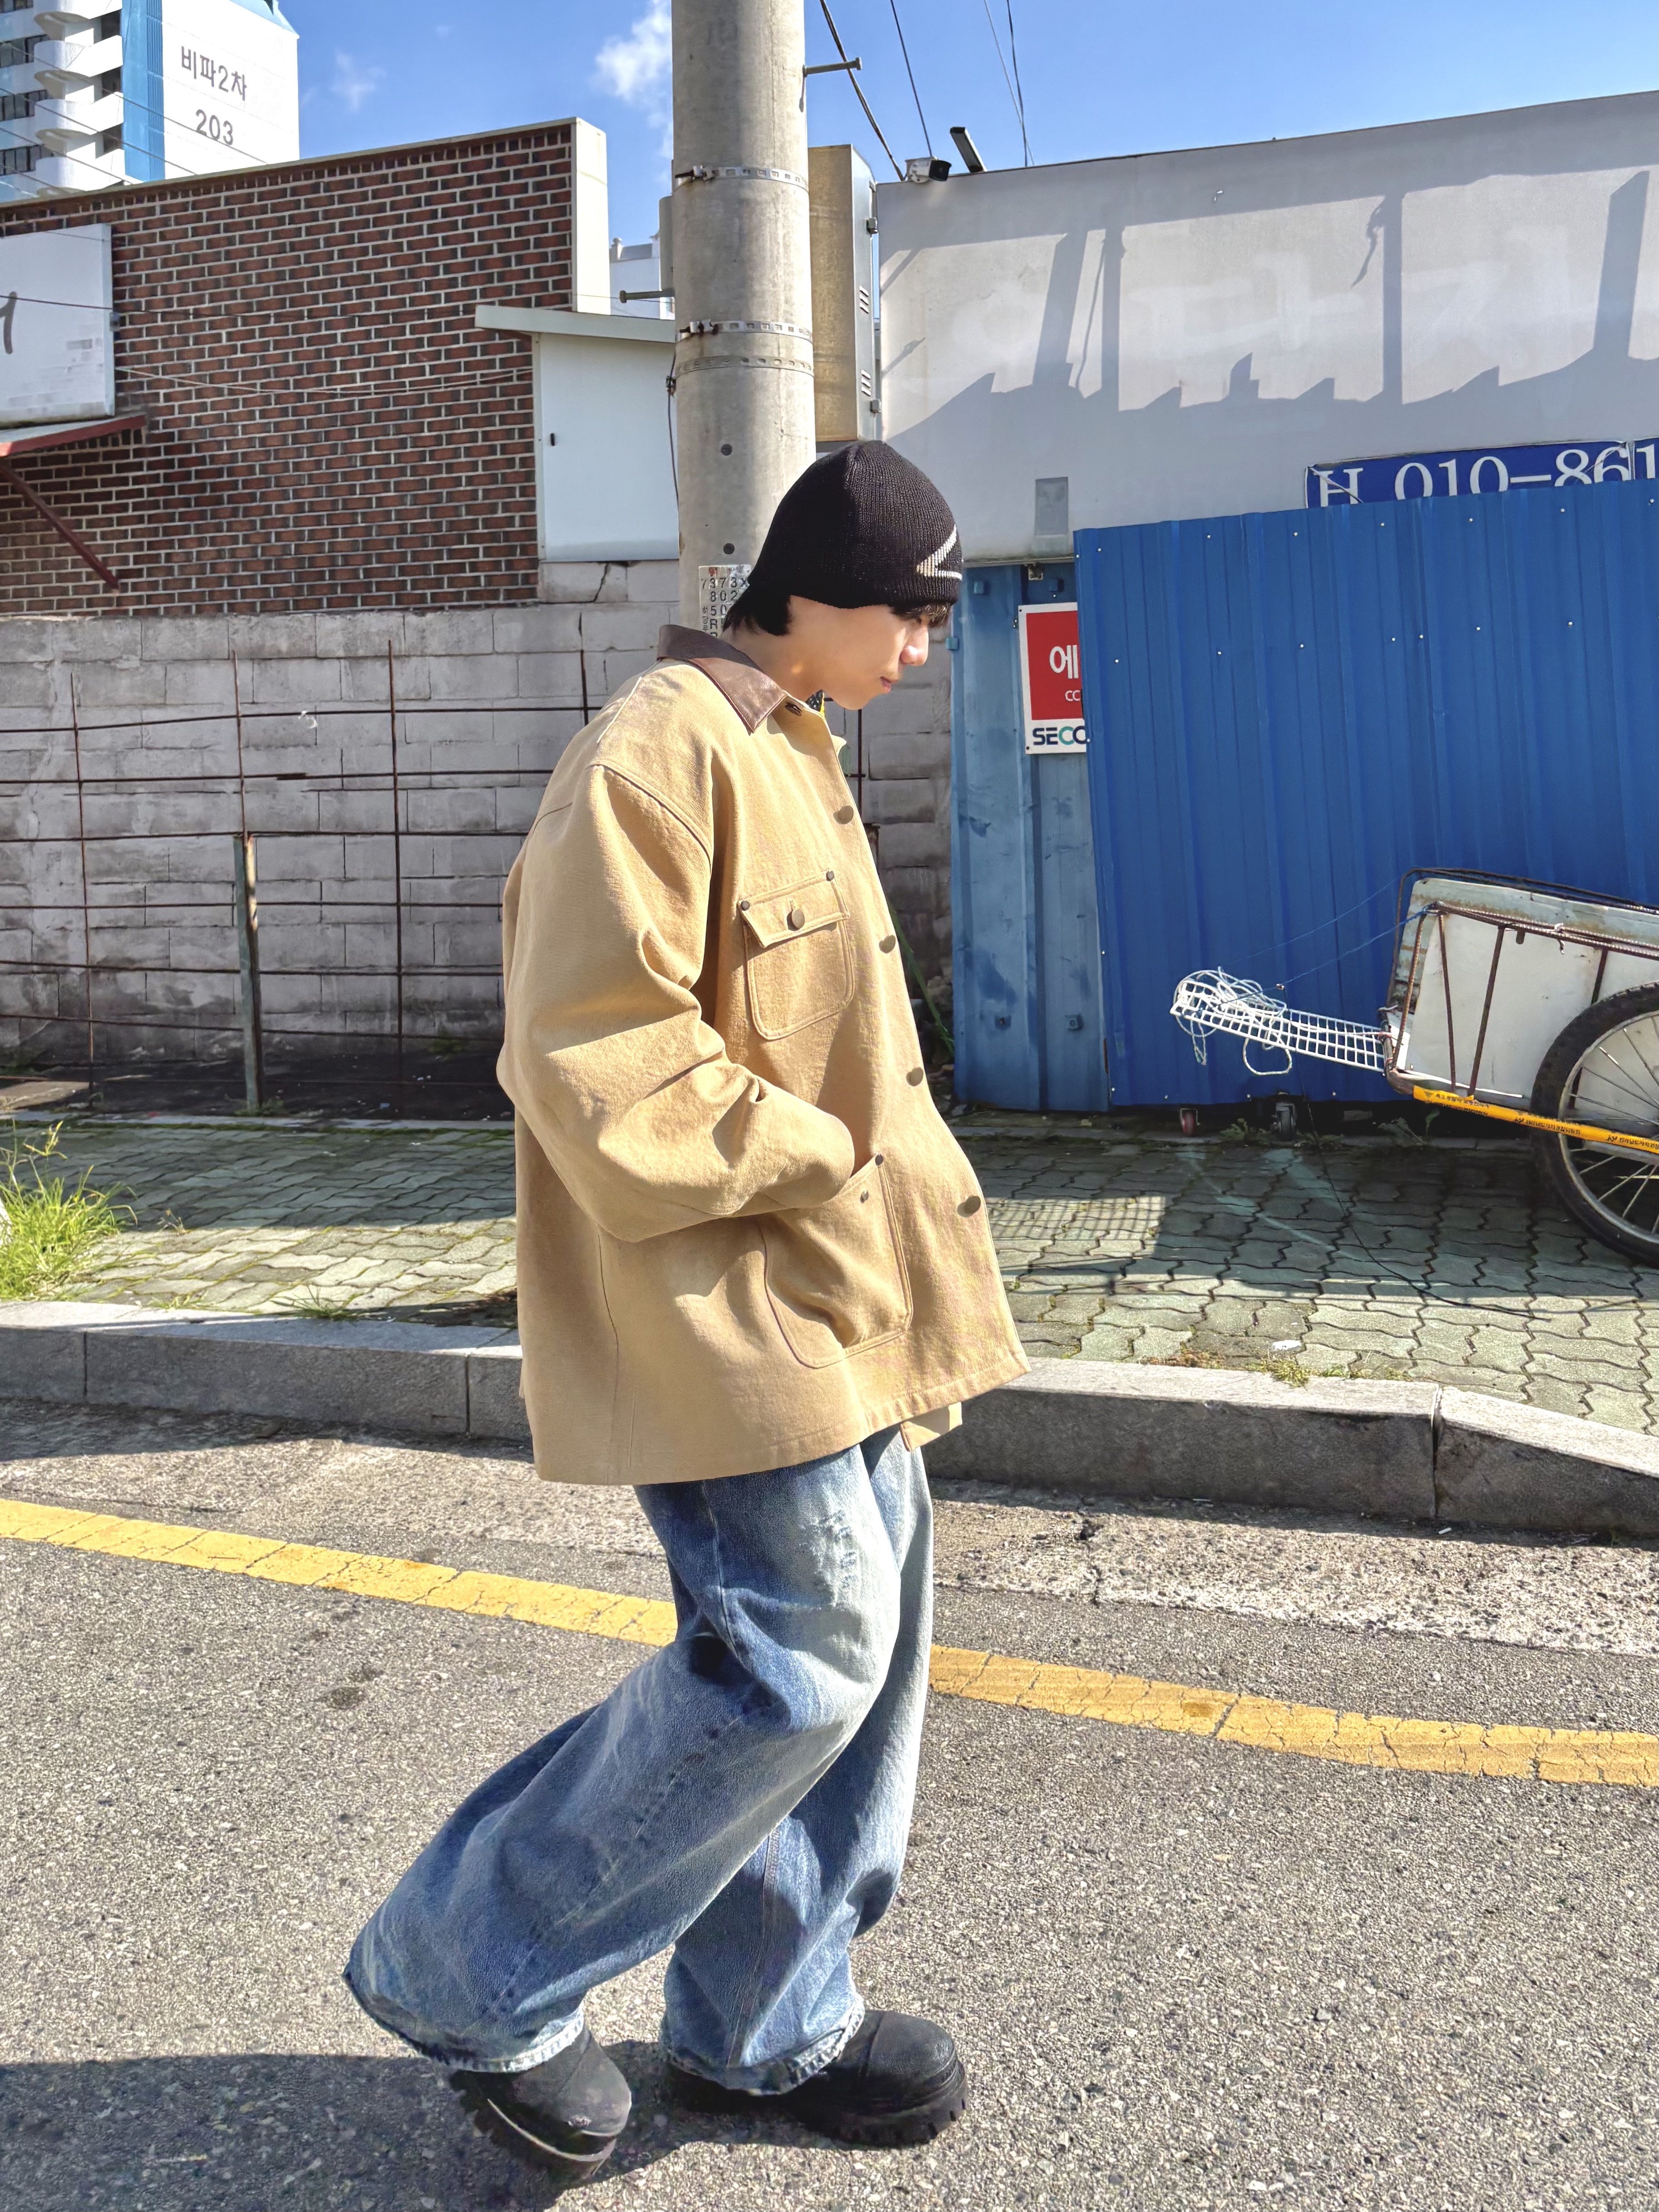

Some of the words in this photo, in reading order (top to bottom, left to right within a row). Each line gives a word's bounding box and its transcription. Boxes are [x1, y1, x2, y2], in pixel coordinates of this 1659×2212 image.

[181, 46, 247, 101] 비파2차
[196, 109, 233, 145] 203
[1049, 645, 1079, 679] 예
